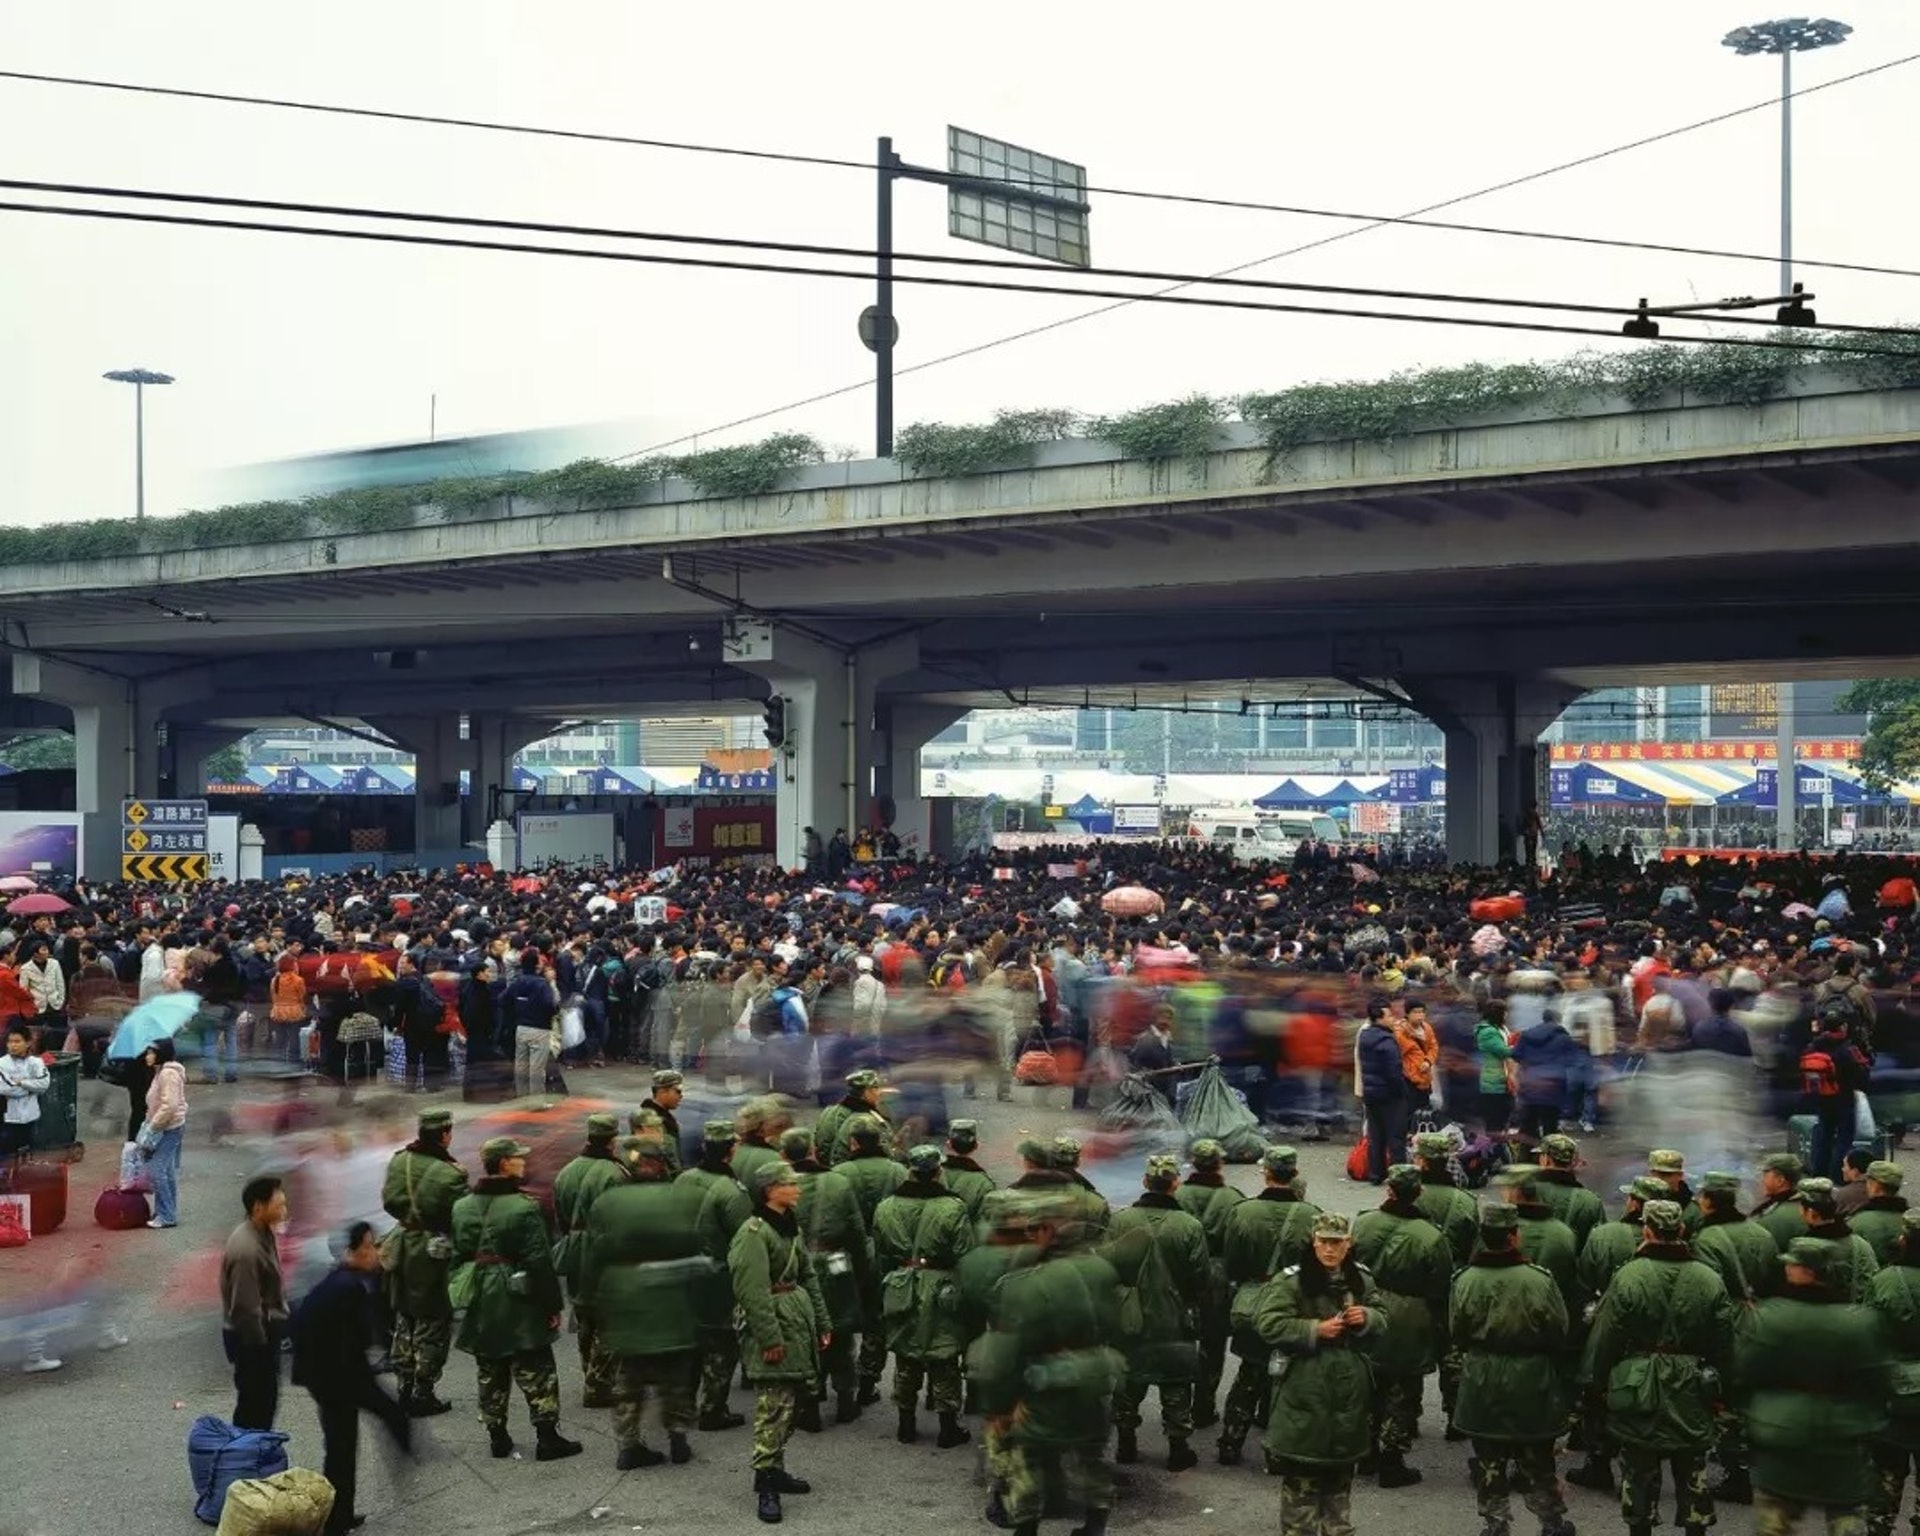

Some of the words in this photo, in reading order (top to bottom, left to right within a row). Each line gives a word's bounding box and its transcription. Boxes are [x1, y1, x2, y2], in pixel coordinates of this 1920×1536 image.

[152, 807, 204, 821] 道路施工
[151, 834, 204, 848] 向左改道
